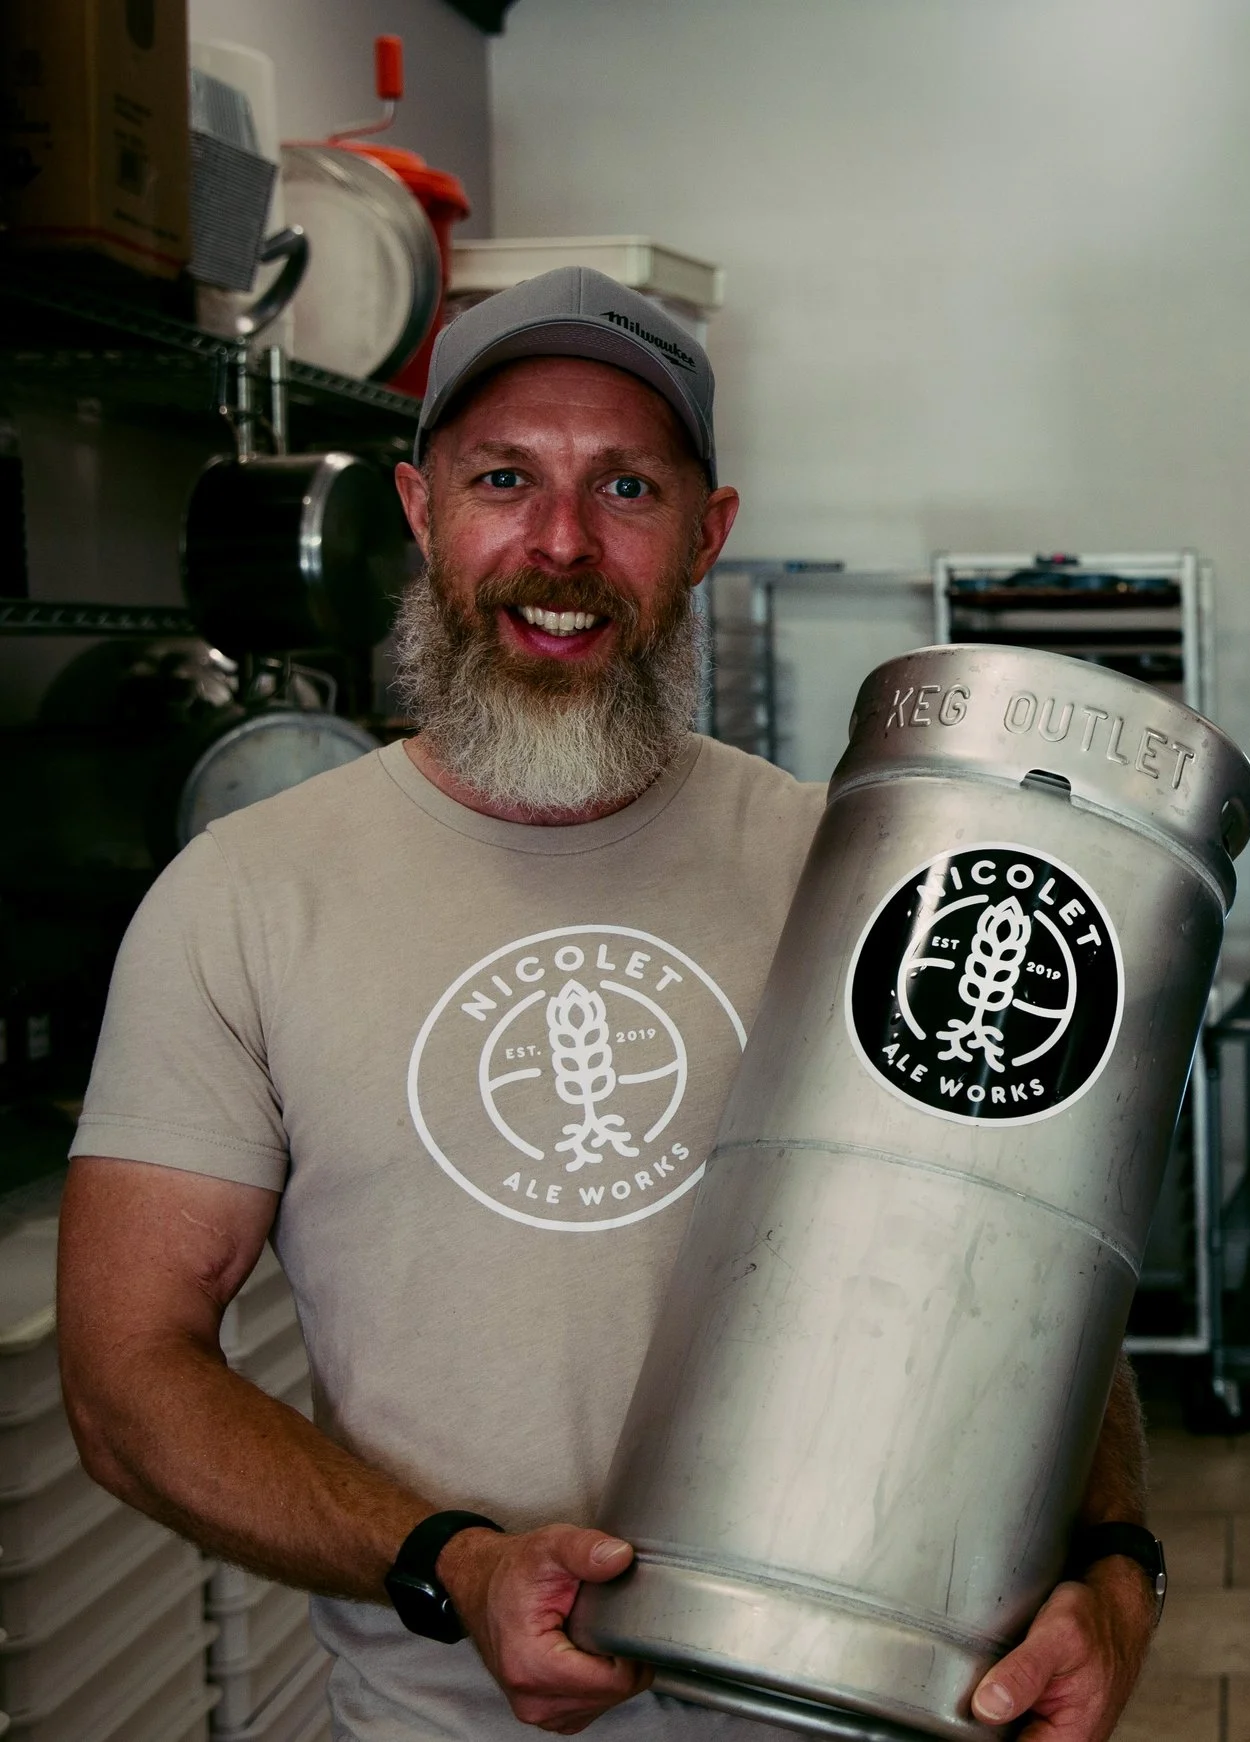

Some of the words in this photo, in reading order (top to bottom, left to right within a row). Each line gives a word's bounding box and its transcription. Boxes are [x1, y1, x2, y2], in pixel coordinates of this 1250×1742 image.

[599, 311, 697, 369] Milwaukee
[886, 684, 971, 730] KEG
[1003, 691, 1196, 790] OUTLET
[916, 860, 1102, 948] NICOLET
[931, 936, 960, 950] EST
[1026, 961, 1062, 981] 2019
[461, 944, 683, 1022] NICOLET
[505, 1045, 542, 1060] EST.
[616, 1028, 657, 1043] 2019
[882, 1043, 928, 1083] ALE
[939, 1076, 1045, 1104] WORKS
[503, 1172, 562, 1204] ALE
[579, 1142, 690, 1206] WORKS
